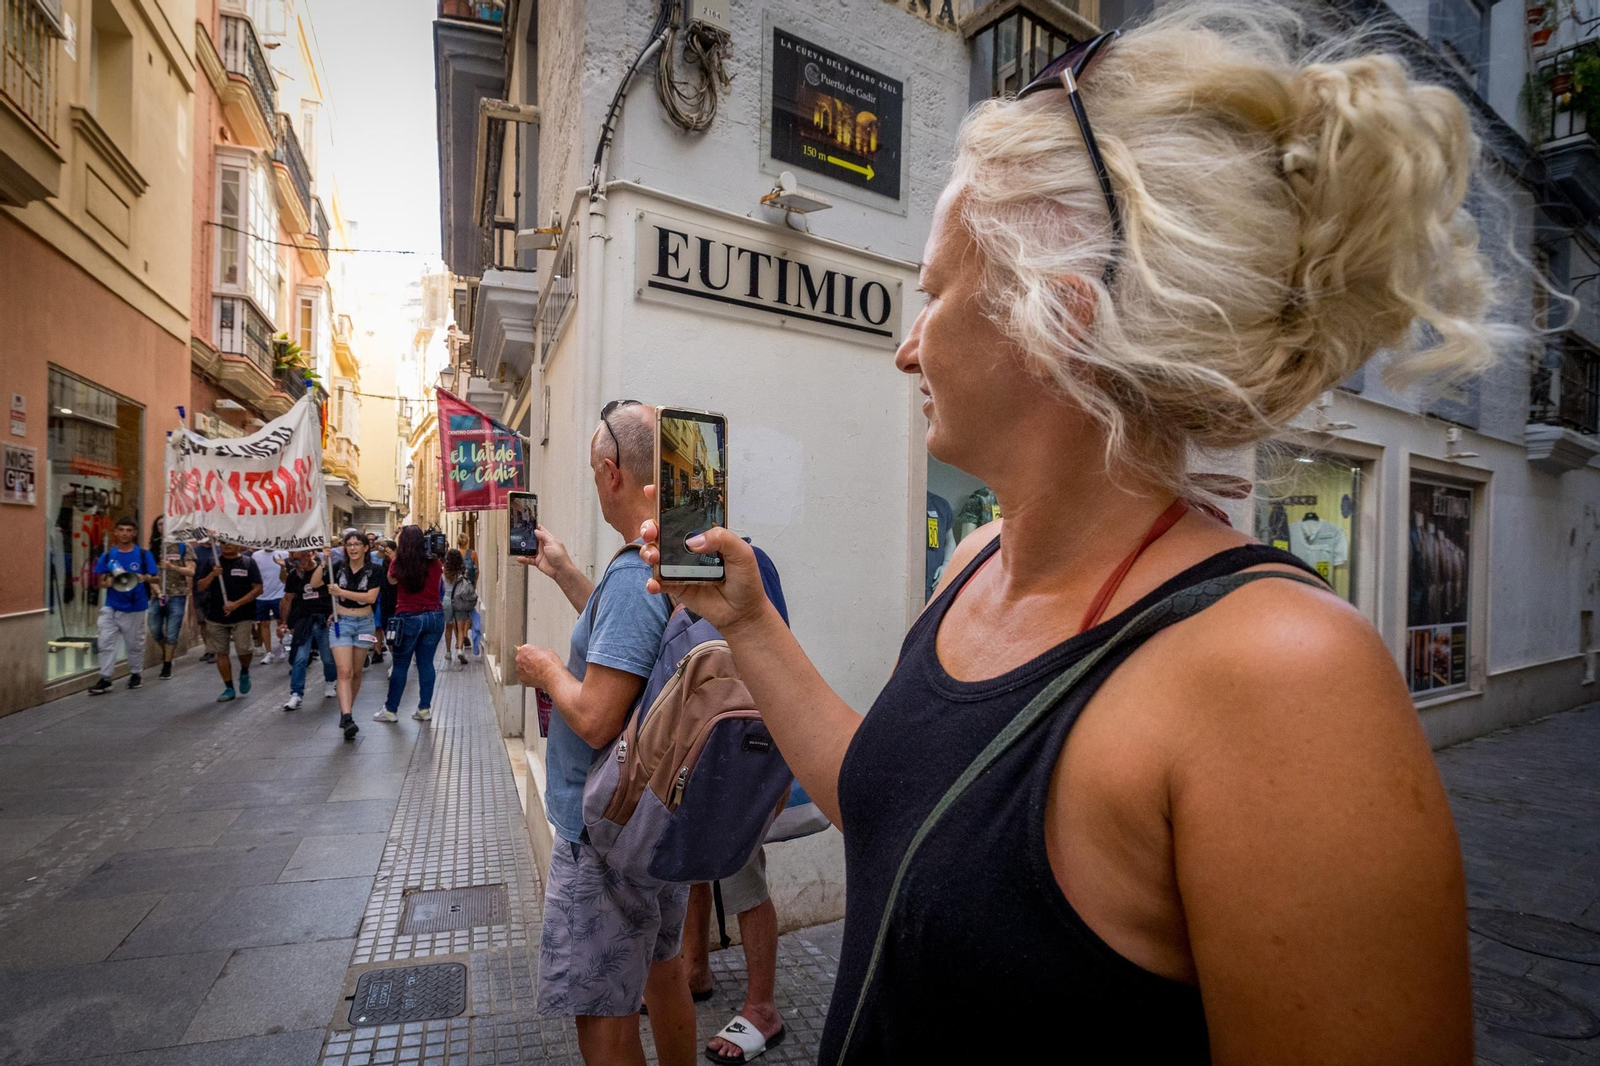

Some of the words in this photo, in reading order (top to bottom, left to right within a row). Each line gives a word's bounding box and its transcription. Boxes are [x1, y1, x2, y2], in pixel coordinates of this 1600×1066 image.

[780, 38, 792, 49] LA
[796, 44, 824, 62] CUEVA
[826, 58, 842, 71] DEL
[844, 66, 876, 85] PAJARO
[878, 81, 898, 94] AZUL
[820, 72, 844, 92] Puerto
[846, 84, 856, 95] de
[856, 89, 877, 104] Gadir
[802, 144, 816, 158] 150
[818, 152, 826, 162] m
[652, 225, 892, 326] EUTIMIO
[6, 450, 33, 470] NICE
[450, 445, 466, 464] El
[471, 440, 516, 463] latido
[450, 465, 471, 482] de
[475, 463, 518, 484] Cádiz
[262, 538, 272, 547] de
[733, 1022, 748, 1032] NIKE
